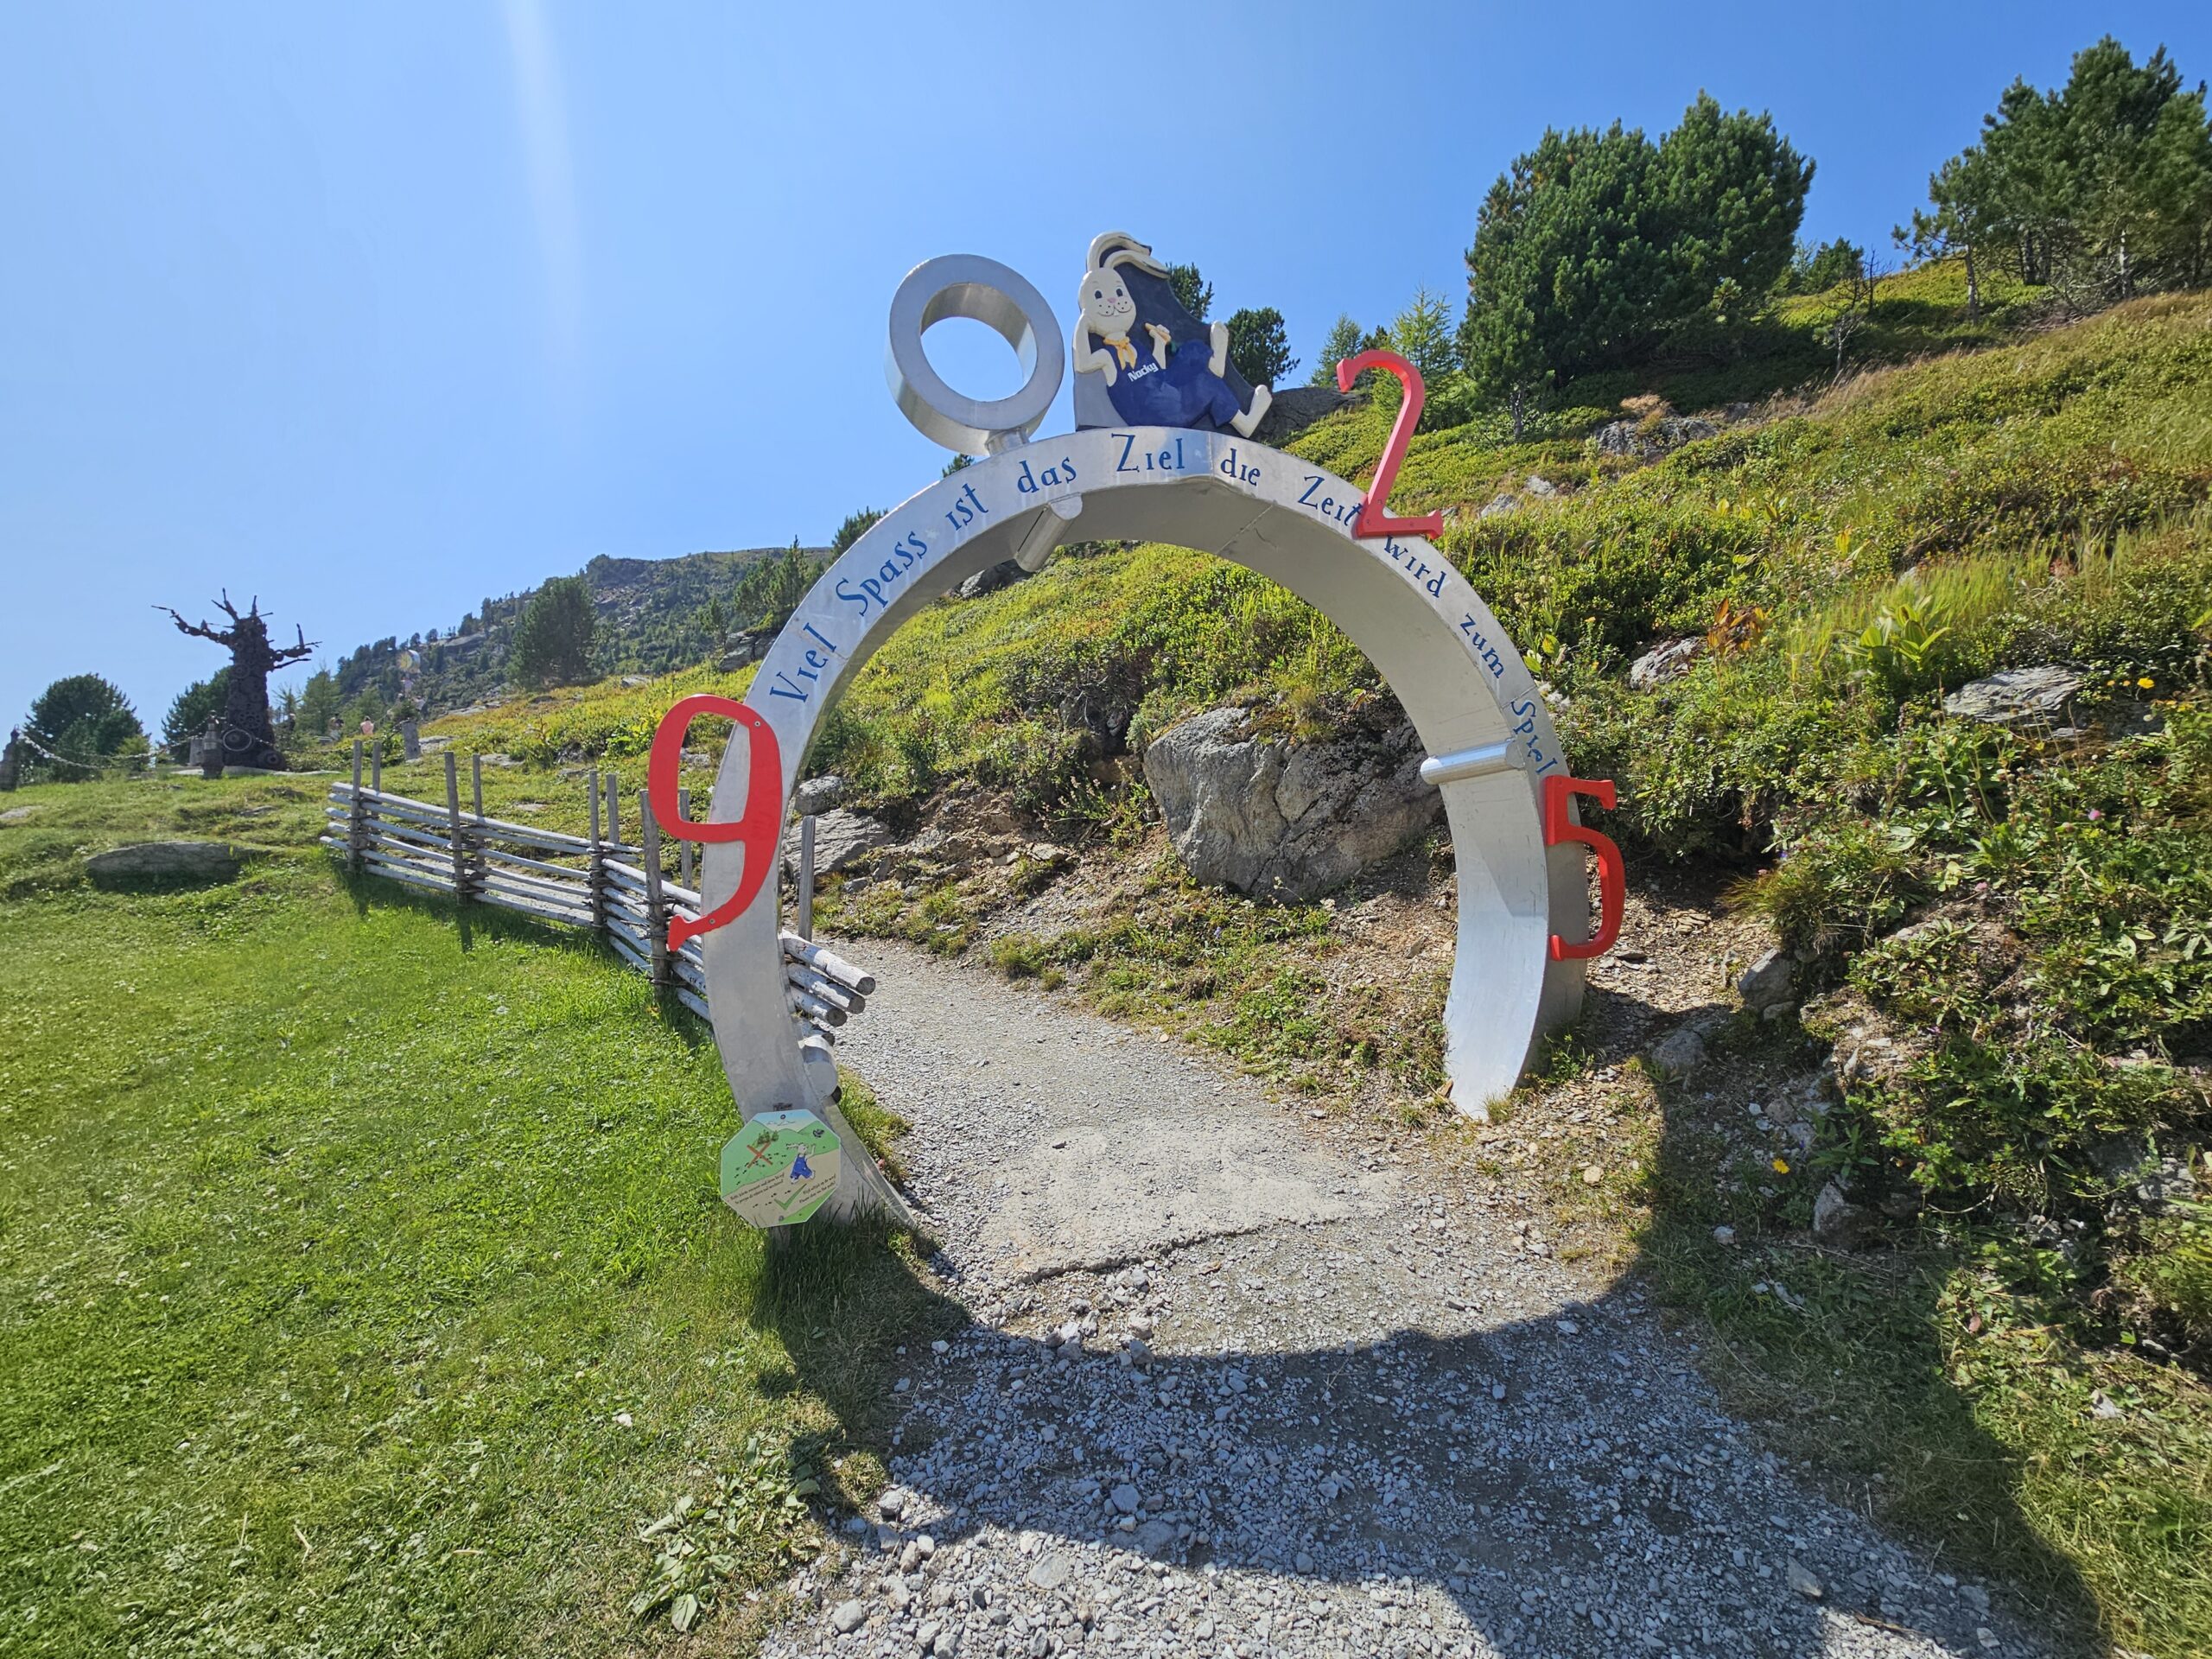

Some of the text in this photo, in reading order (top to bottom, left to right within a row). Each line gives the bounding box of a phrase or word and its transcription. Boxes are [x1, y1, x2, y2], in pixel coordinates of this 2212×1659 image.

[1127, 362, 1159, 382] Nocky
[1336, 349, 1444, 540] 2
[769, 433, 1558, 774] Viel Spass ist das Ziel die Zeit wird zum Spiel
[648, 693, 783, 952] 9
[1545, 774, 1625, 961] 5
